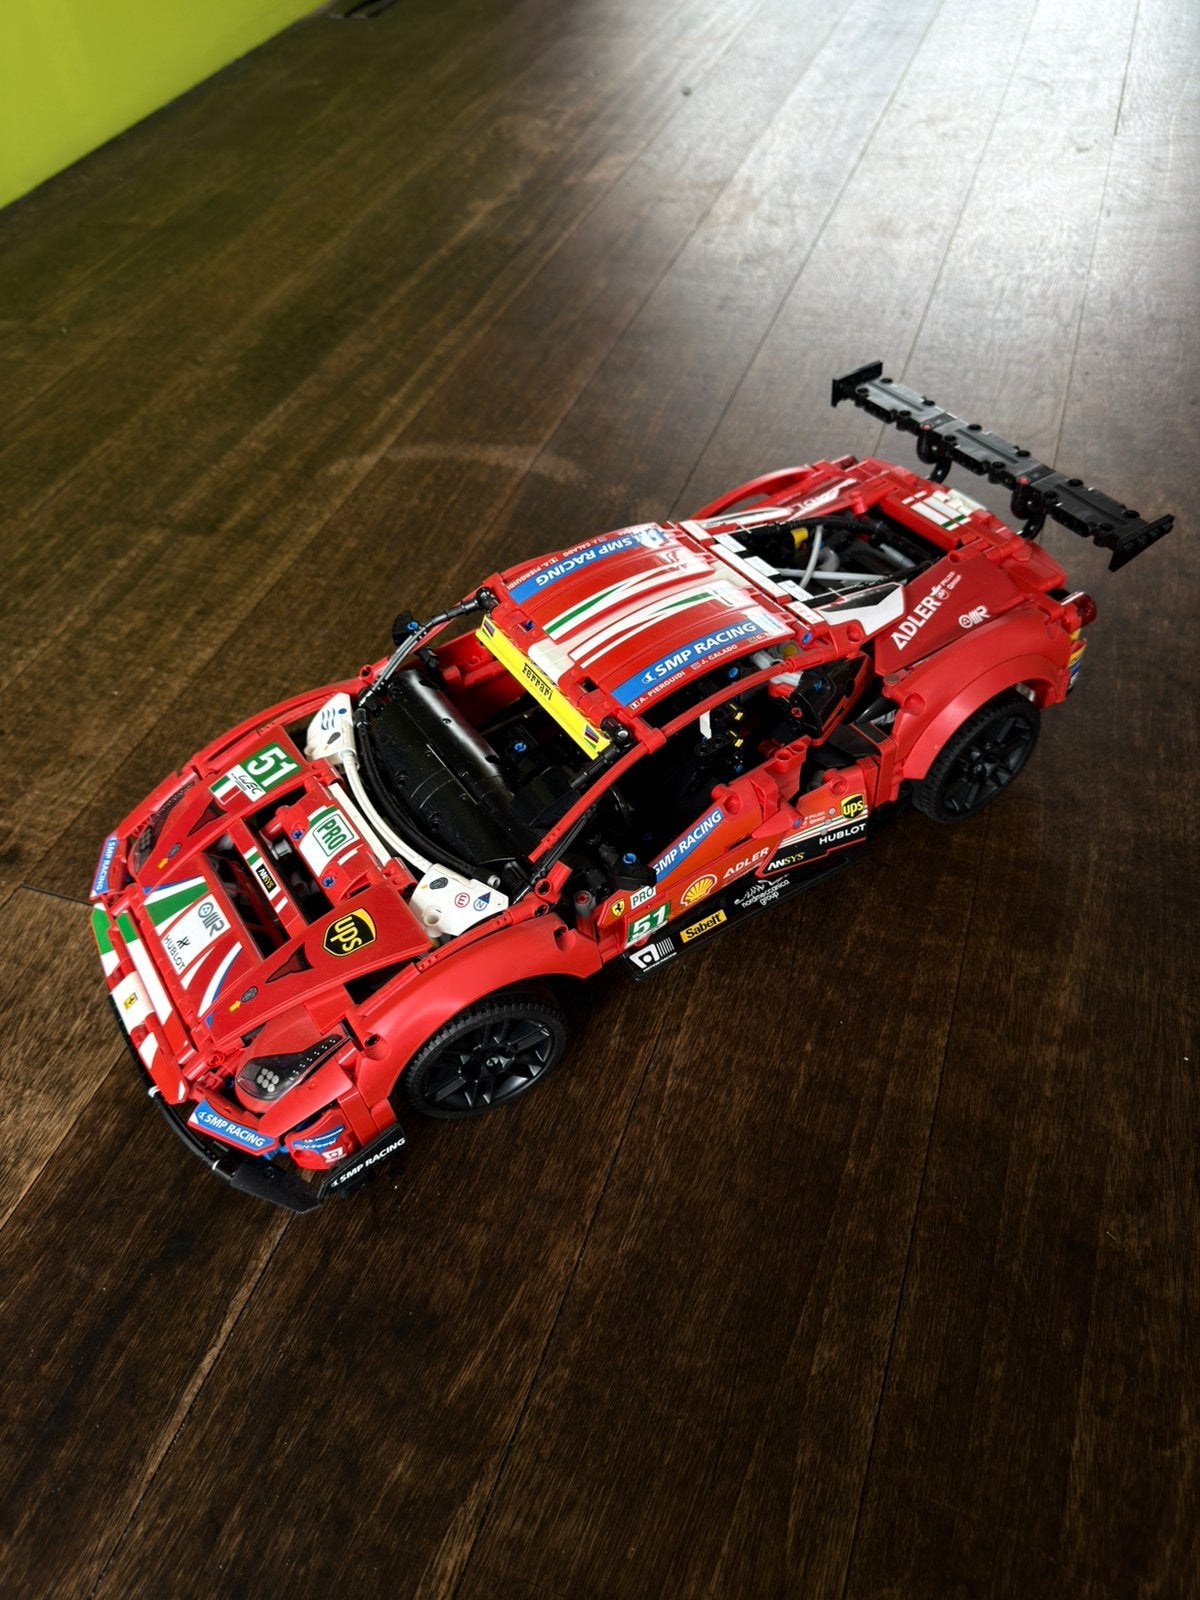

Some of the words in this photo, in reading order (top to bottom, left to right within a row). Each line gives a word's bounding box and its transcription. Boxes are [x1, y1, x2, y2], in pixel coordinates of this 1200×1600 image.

[599, 536, 633, 555] SMP
[536, 550, 597, 586] RACING
[890, 596, 942, 651] ADLER
[655, 649, 692, 677] SMP
[693, 622, 757, 655] RACING
[708, 644, 738, 661] CALADO
[522, 662, 554, 701] Ferrari
[647, 670, 686, 697] PIERGUIDI
[247, 746, 299, 788] 51
[843, 800, 864, 818] ups
[316, 818, 347, 851] PRO
[652, 849, 679, 876] SMP
[678, 810, 722, 854] RACING
[818, 822, 867, 846] HUBLOT
[95, 859, 111, 891] RACING
[722, 846, 770, 880] ADLER
[767, 851, 806, 872] ANSYS
[632, 887, 654, 907] PRO
[759, 891, 780, 907] group
[330, 916, 363, 952] ups
[631, 904, 667, 940] 51
[685, 912, 722, 939] Sabelt
[163, 934, 186, 971] HUBLOT
[204, 1113, 229, 1132] SMP
[225, 1123, 266, 1148] RACING
[338, 1164, 364, 1185] SMP
[363, 1137, 406, 1172] RACING
